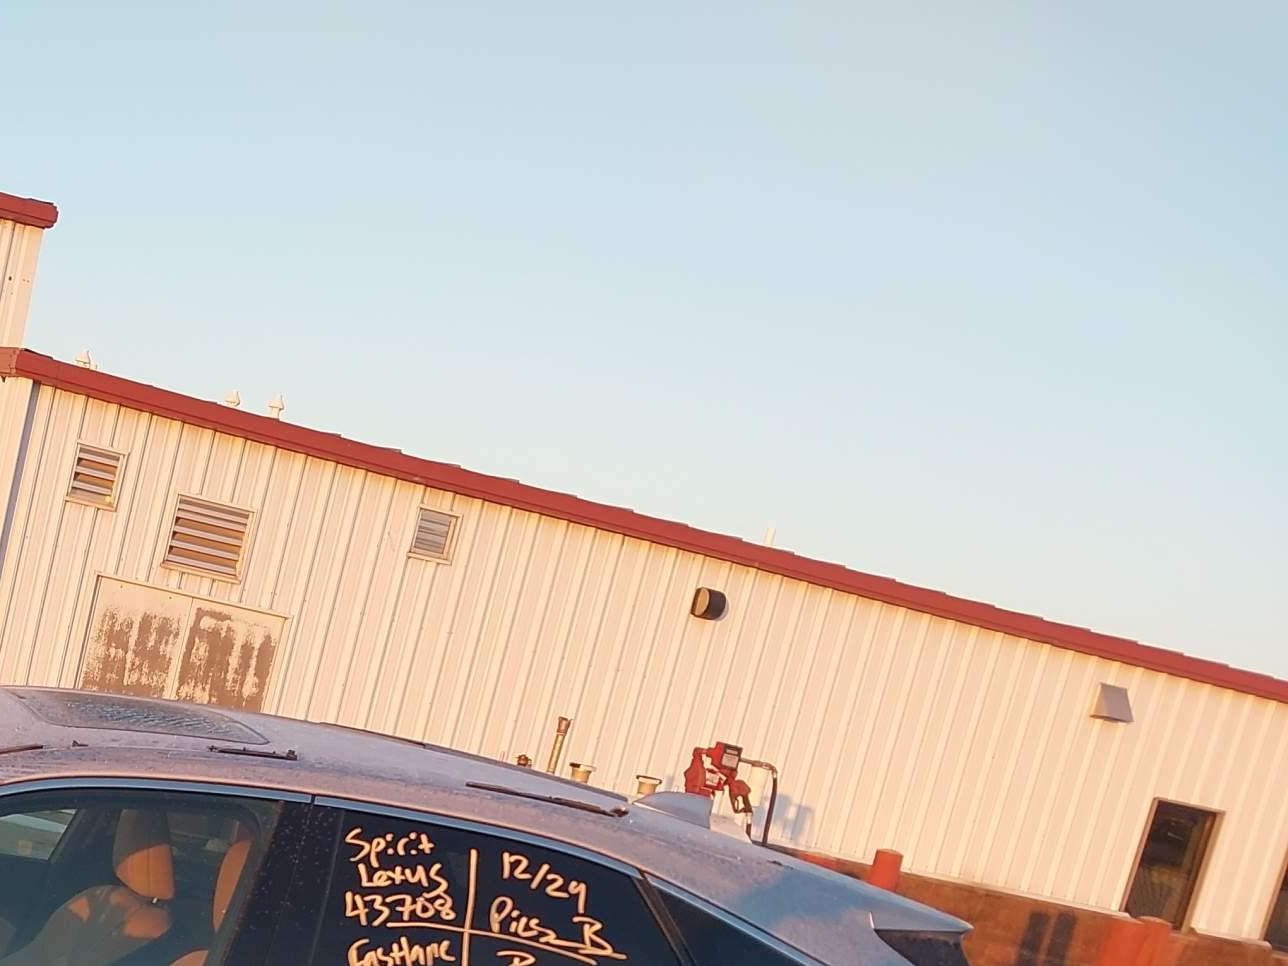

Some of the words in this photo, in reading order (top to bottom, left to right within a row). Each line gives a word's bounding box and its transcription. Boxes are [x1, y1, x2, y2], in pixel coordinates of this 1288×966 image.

[345, 828, 434, 868] Spirit
[358, 863, 448, 898] Lexus
[345, 890, 456, 926] 43708
